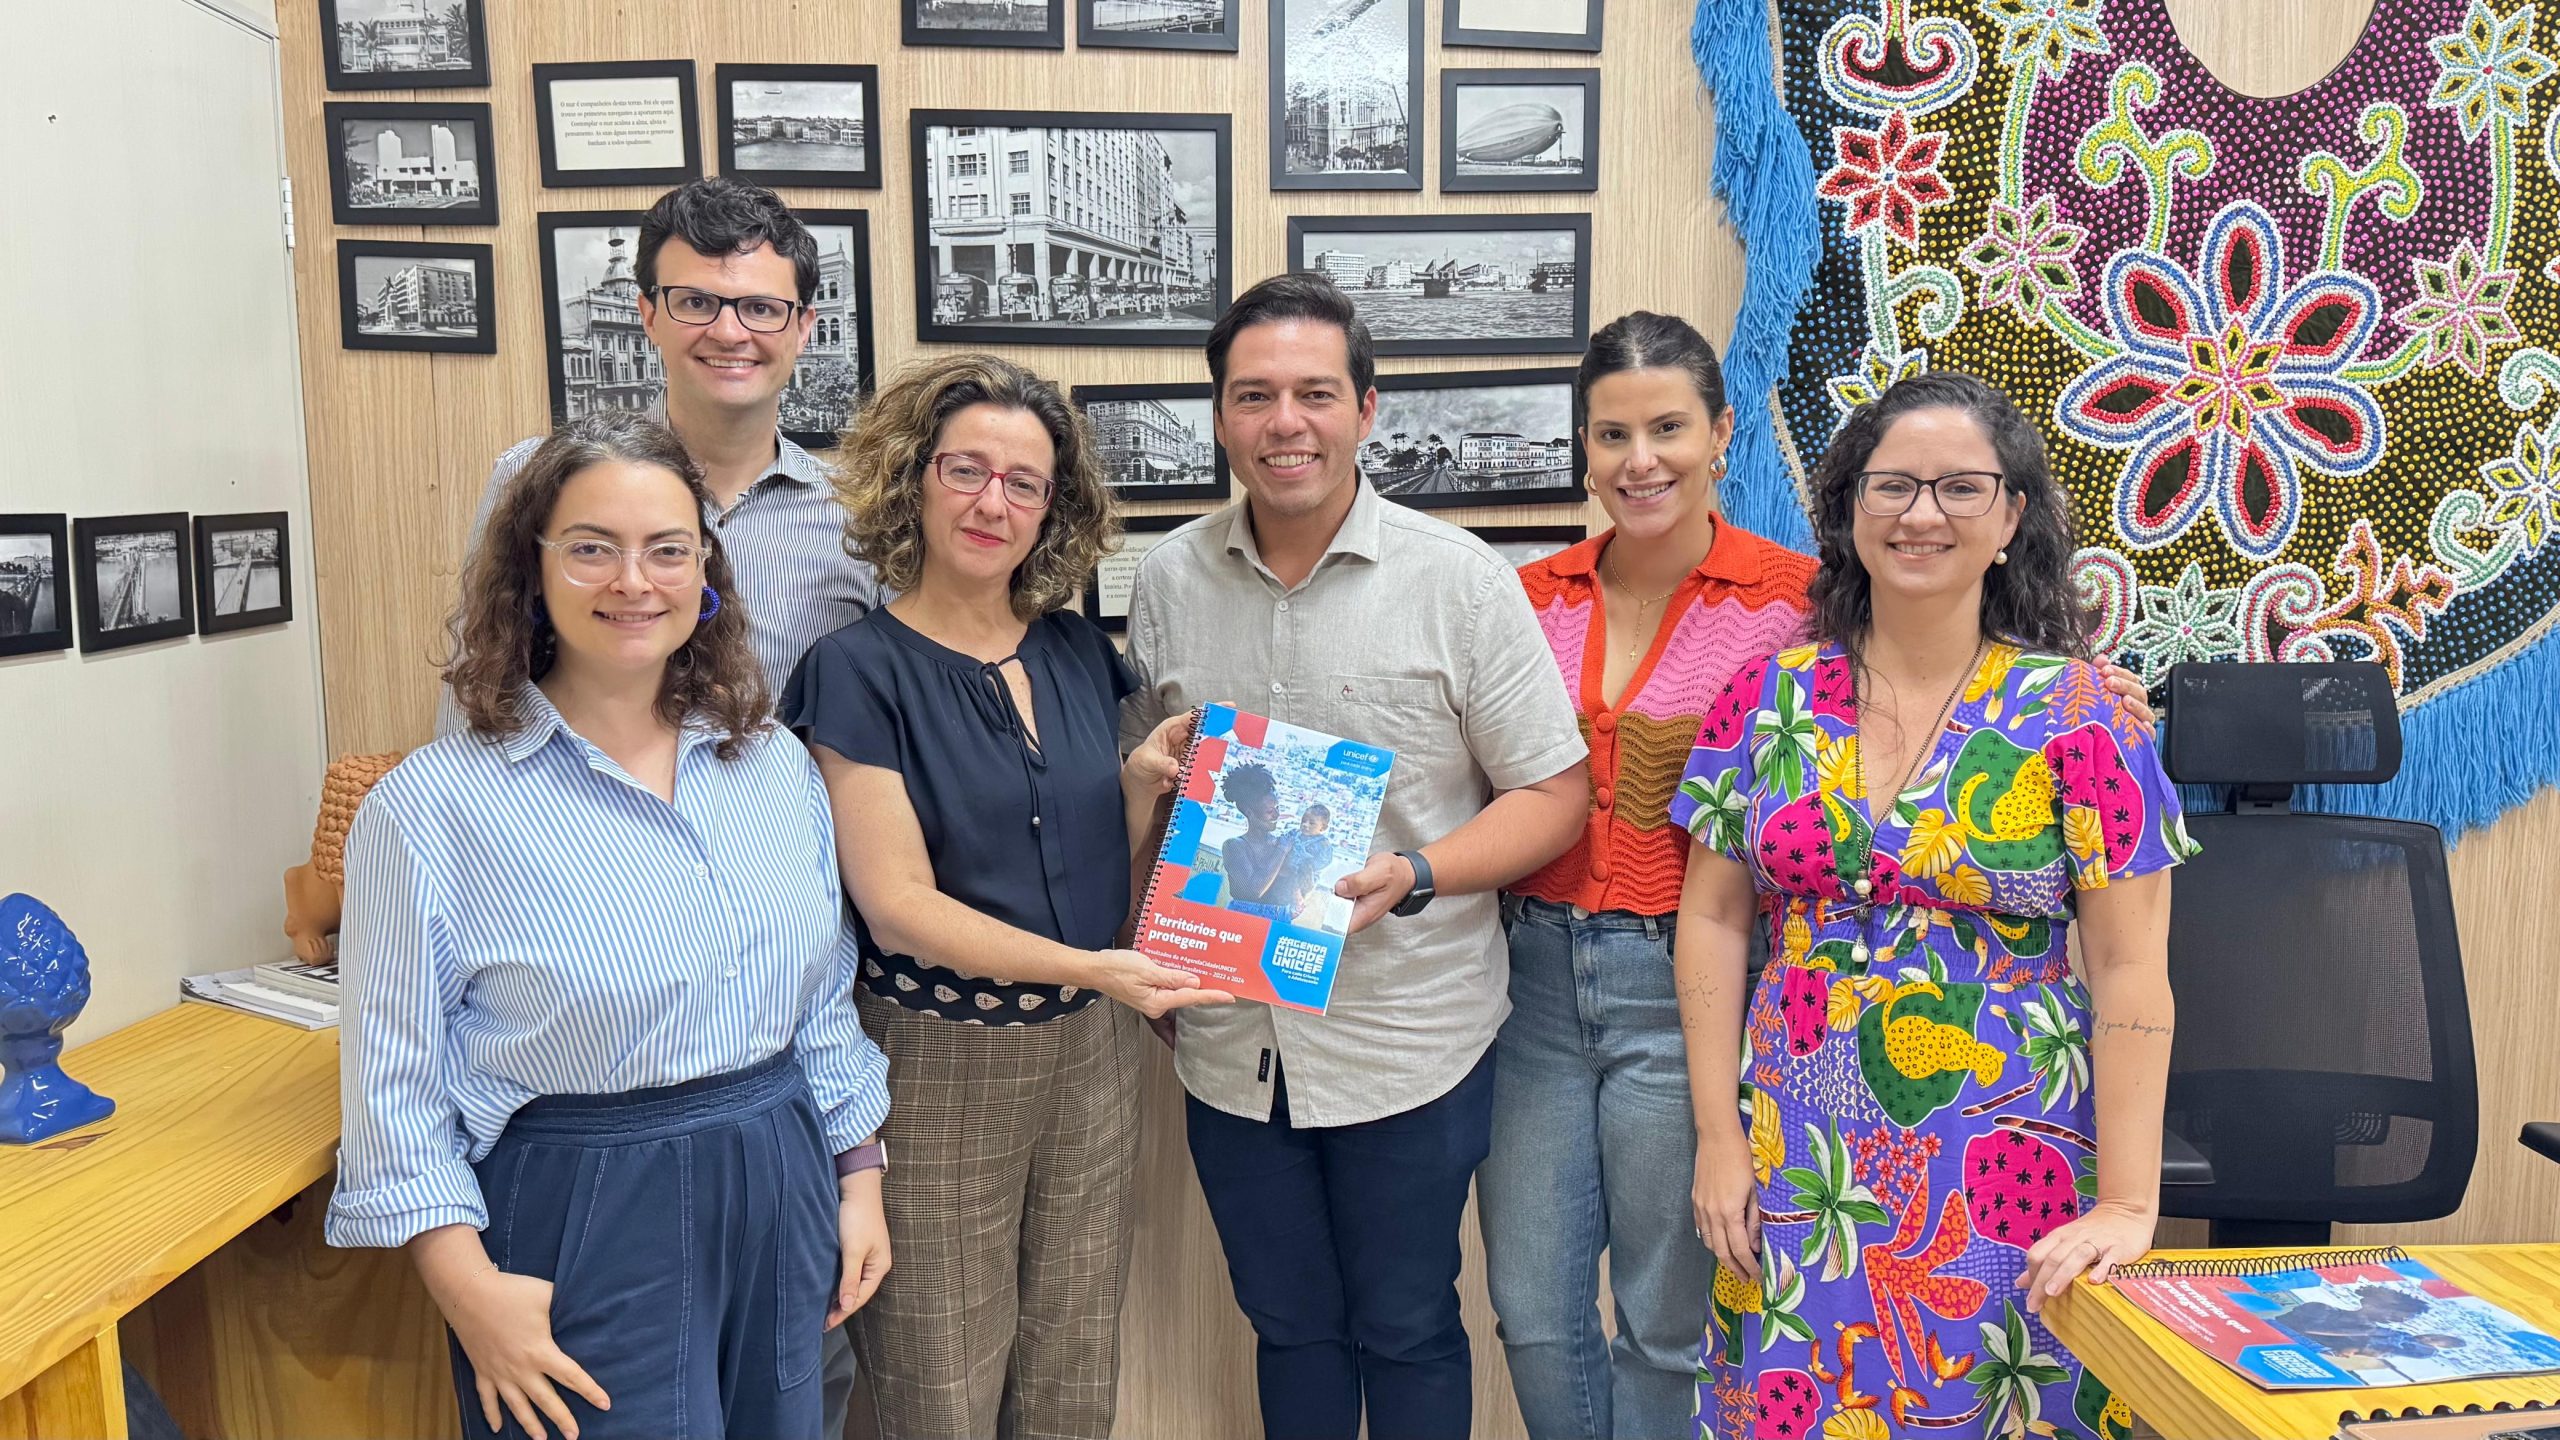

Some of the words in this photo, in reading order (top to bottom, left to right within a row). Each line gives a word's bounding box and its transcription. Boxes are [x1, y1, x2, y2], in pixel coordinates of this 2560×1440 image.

[1343, 750, 1369, 760] unicef
[1154, 913, 1217, 937] Territórios
[1219, 930, 1242, 943] que
[1148, 929, 1208, 951] protegem
[1278, 936, 1328, 955] #AGENDA
[1145, 948, 1172, 959] Resultados
[1180, 956, 1237, 973] #AgendaCidadeUNICEF
[1272, 954, 1323, 974] UNICEF
[1274, 944, 1325, 965] CIDADE
[2154, 1280, 2210, 1318] protegem
[2176, 1280, 2230, 1320] Territórios
[2226, 1319, 2252, 1334] que
